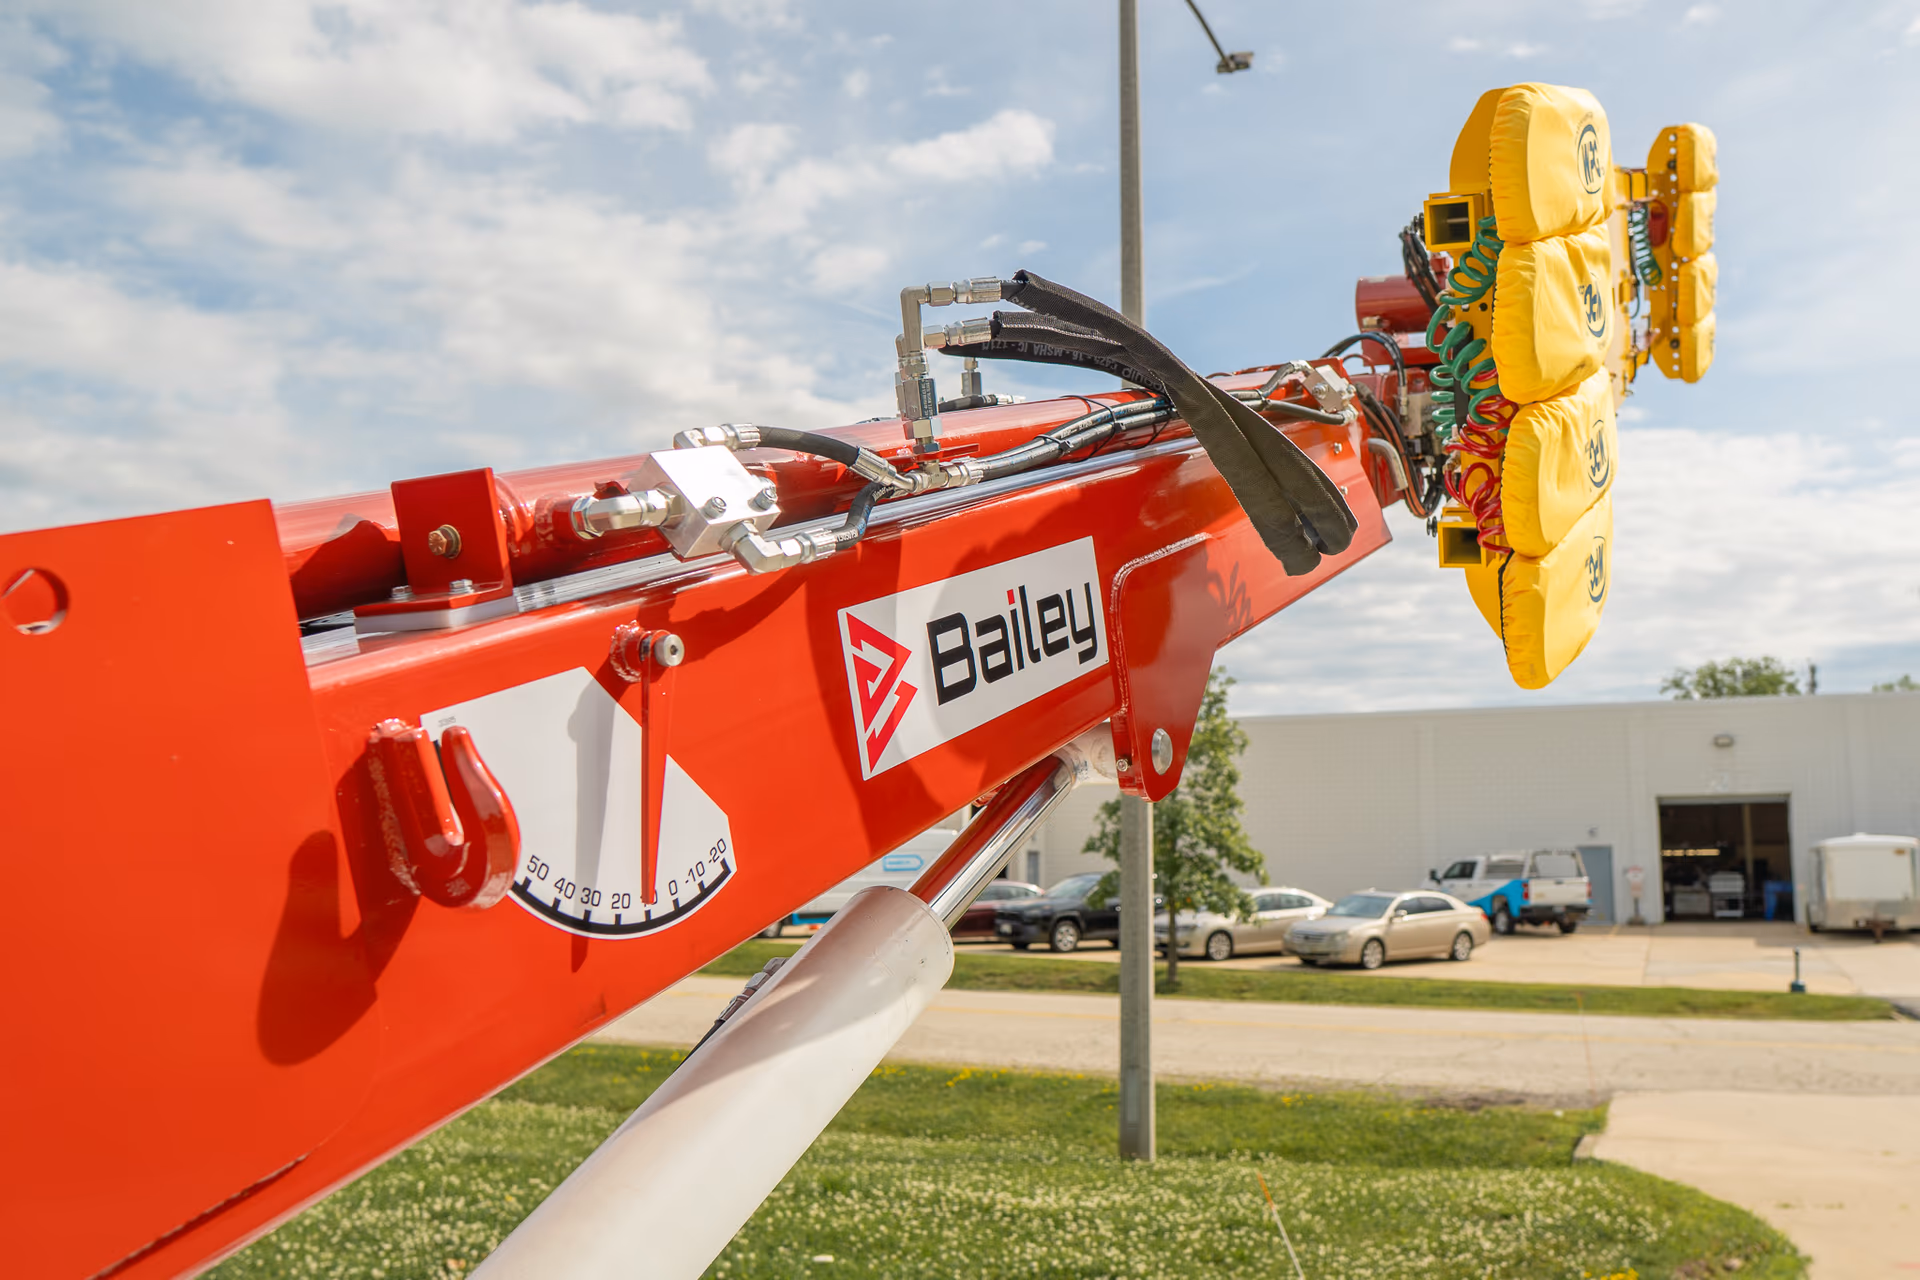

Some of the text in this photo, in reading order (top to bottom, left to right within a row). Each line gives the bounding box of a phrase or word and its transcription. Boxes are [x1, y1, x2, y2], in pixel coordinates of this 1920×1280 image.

[926, 581, 1098, 706] Bailey
[526, 855, 550, 881] 50
[553, 877, 576, 900] 40
[580, 887, 601, 907] 30
[611, 893, 631, 910] 20
[668, 879, 678, 896] 0
[684, 861, 706, 884] -10
[708, 838, 727, 865] -20
